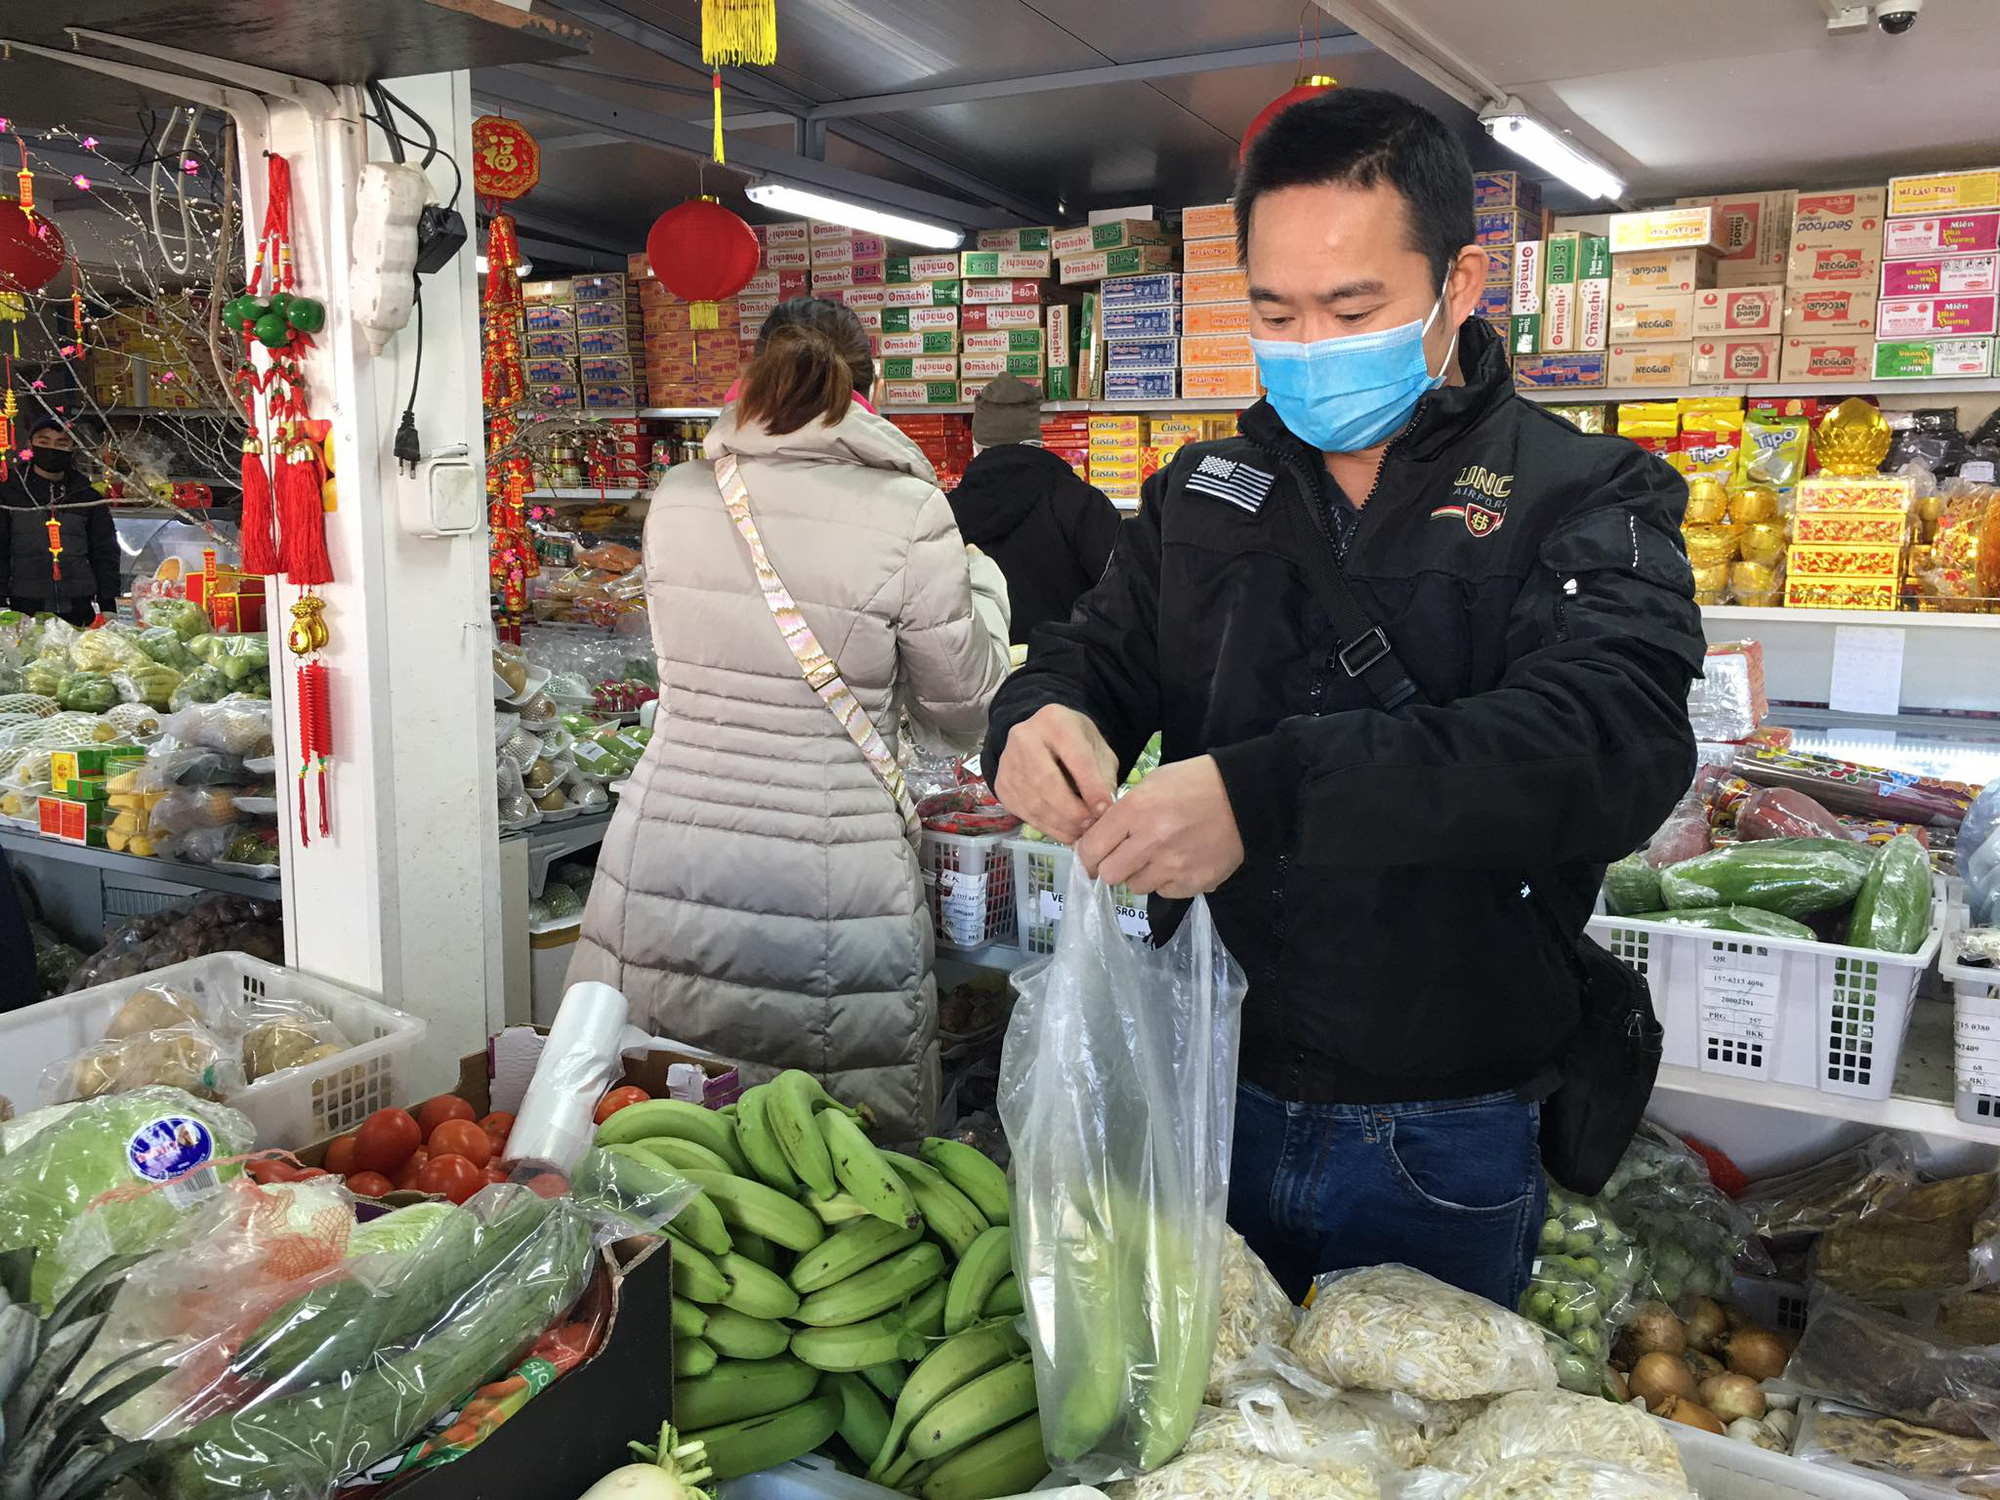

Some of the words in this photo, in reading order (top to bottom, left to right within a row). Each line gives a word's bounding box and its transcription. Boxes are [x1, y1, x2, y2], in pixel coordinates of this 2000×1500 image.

[1796, 219, 1854, 235] Seafood
[1632, 265, 1668, 275] NEOGURI
[1818, 261, 1859, 271] NEOGURI
[1519, 246, 1534, 303] Omachi
[1806, 301, 1847, 311] NEOGURI
[1585, 290, 1601, 348] Omachi
[1736, 310, 1761, 318] pong
[1552, 294, 1566, 346] Omachi
[1637, 320, 1673, 329] NEOGURI
[1734, 361, 1759, 369] pong
[1811, 357, 1852, 367] NEOGURI
[1635, 365, 1671, 374] NEOGURI
[1090, 420, 1119, 430] Custas
[1161, 422, 1192, 432] Custas
[1091, 436, 1119, 446] Custas
[1755, 429, 1796, 449] Tipo
[1091, 452, 1119, 462] Custas
[1688, 446, 1729, 464] Tipo
[1090, 468, 1119, 478] Custas
[1454, 465, 1514, 498] UNC
[1115, 905, 1136, 917] SRO
[1713, 955, 1726, 963] QR
[1746, 1029, 1764, 1038] BKK
